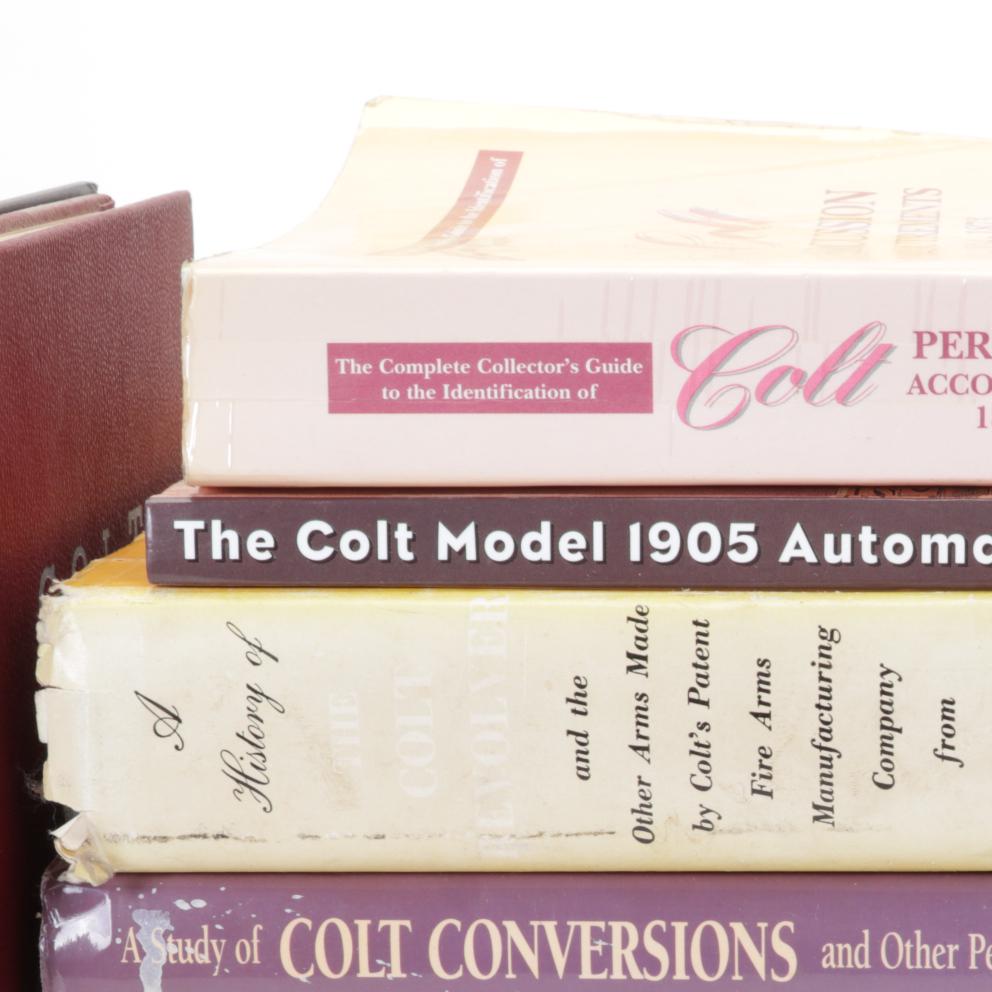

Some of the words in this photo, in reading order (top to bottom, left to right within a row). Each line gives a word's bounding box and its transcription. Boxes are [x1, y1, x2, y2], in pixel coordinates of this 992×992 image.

[335, 358, 372, 374] The
[379, 358, 470, 379] Complete
[477, 358, 579, 374] Collector's
[586, 358, 643, 373] Guide
[382, 387, 400, 399] to
[407, 384, 436, 399] the
[443, 384, 570, 400] Identification
[577, 384, 598, 399] of
[670, 321, 894, 429] Colt
[174, 520, 274, 560] The
[297, 520, 414, 561] Colt
[438, 521, 603, 561] Model
[629, 522, 758, 563] 1905
[226, 622, 279, 666] of
[626, 604, 650, 678] Made
[688, 620, 710, 708] Patent
[134, 691, 184, 751] A
[566, 676, 588, 716] the
[629, 693, 650, 763] Arms
[750, 658, 771, 731] Arms
[811, 626, 842, 826] Manufacturing
[872, 664, 902, 790] Company
[221, 684, 285, 813] History
[567, 730, 590, 780] and
[689, 722, 713, 791] Colt's
[933, 698, 964, 768] from
[751, 746, 773, 799] Fire
[631, 775, 655, 844] Other
[692, 804, 722, 832] by
[120, 926, 141, 963] A
[151, 924, 226, 976] Study
[235, 924, 263, 964] of
[279, 917, 412, 981] COLT
[429, 919, 797, 982] CONVERSIONS
[822, 929, 871, 968] and
[881, 930, 959, 969] Other
